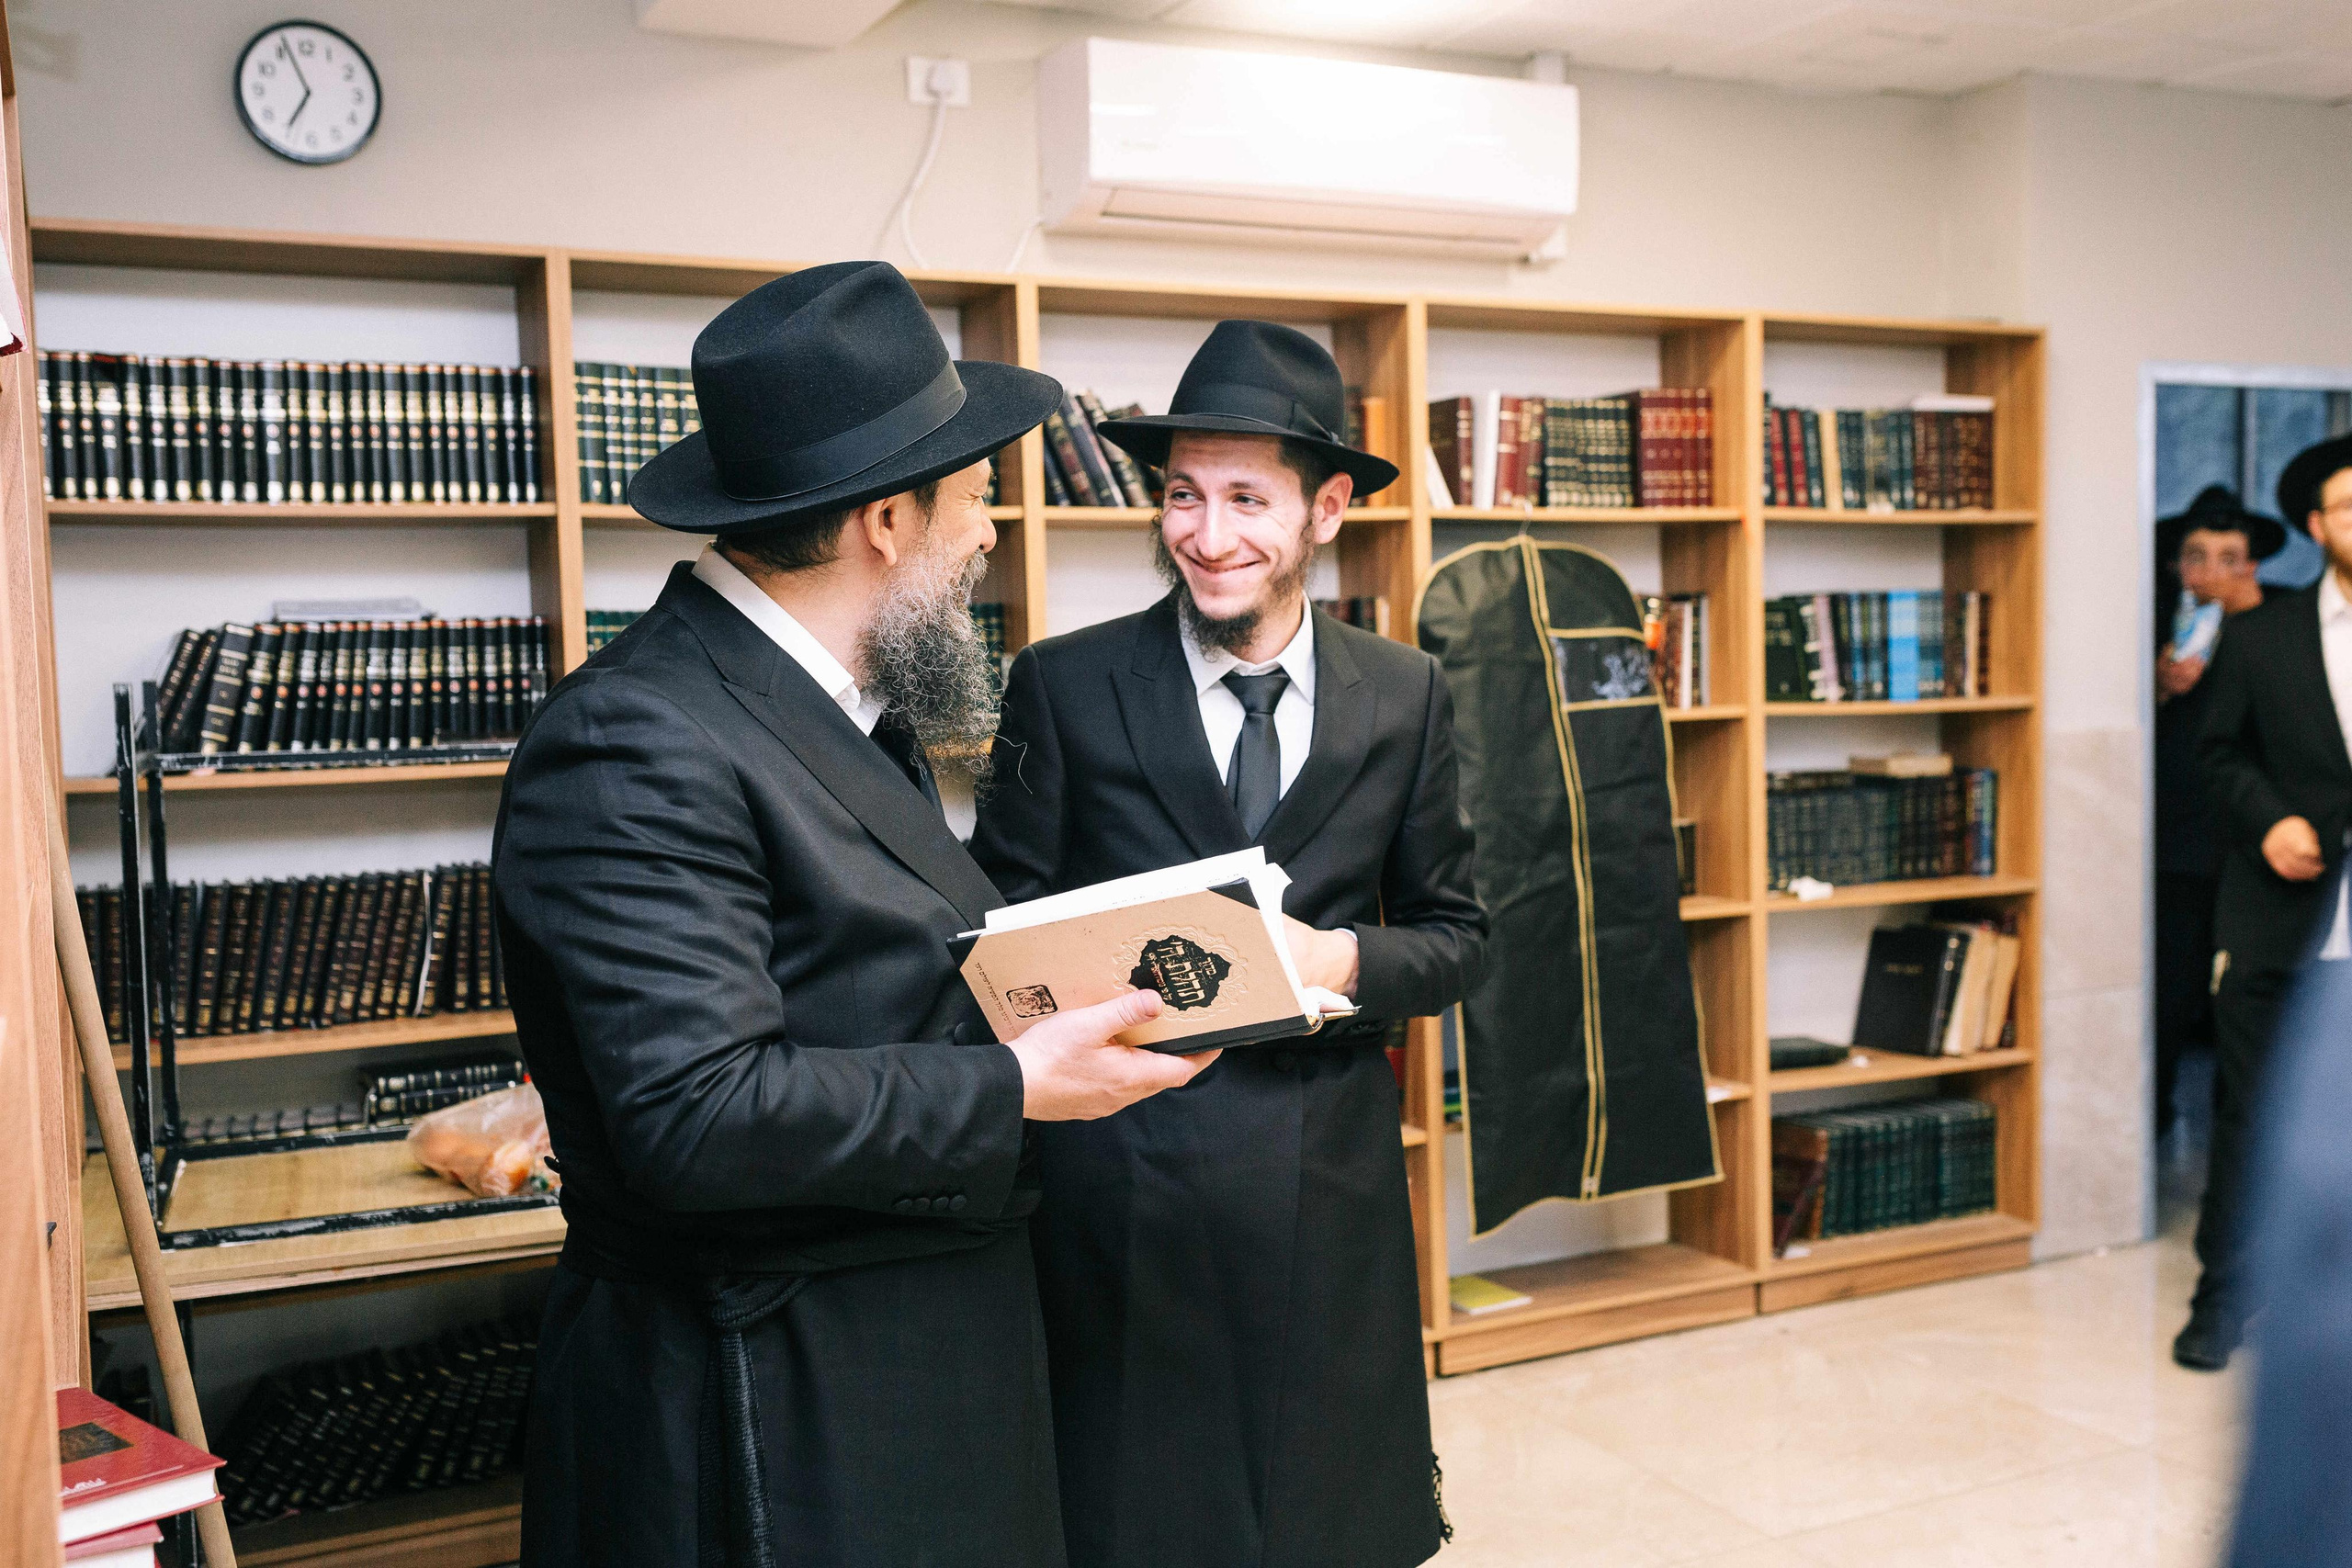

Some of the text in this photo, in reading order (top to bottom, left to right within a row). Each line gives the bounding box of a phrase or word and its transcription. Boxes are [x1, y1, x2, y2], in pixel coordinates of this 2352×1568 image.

[324, 45, 334, 62] 1
[257, 60, 277, 78] 10
[342, 62, 355, 82] 2
[351, 86, 365, 106] 3
[346, 109, 358, 127] 4
[305, 130, 319, 148] 6
[1164, 961, 1205, 1004] תהלת
